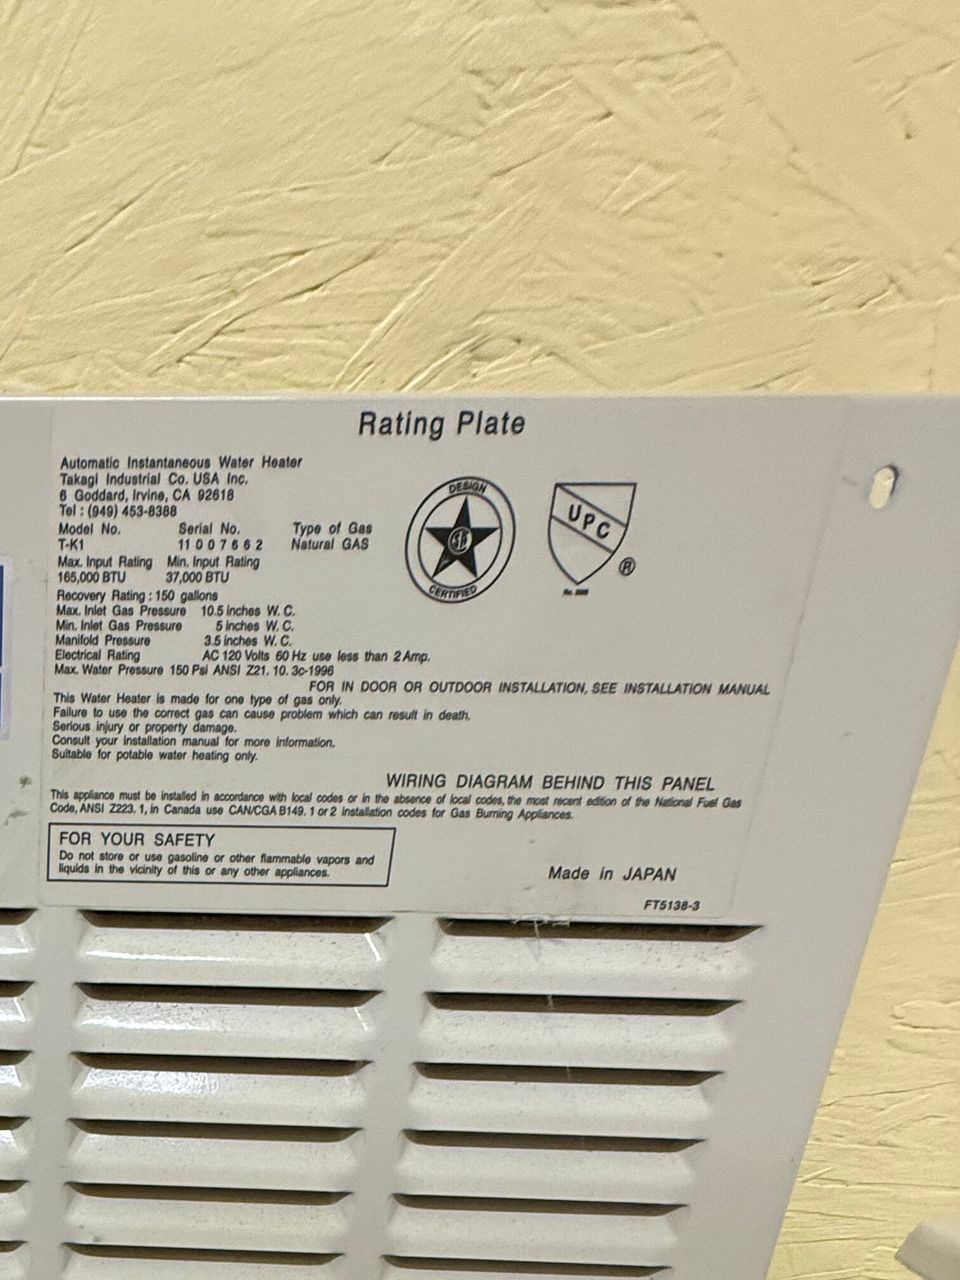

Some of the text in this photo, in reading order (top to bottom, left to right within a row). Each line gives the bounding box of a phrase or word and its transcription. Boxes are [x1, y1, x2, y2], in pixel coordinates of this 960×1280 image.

[358, 410, 525, 441] Rating Plate
[59, 455, 303, 469] Automatic Instantaneous Water Heater
[59, 471, 248, 488] Takagi Industrial Co. USA Inc.
[58, 487, 234, 502] 6 Goddard, Irvine, CA 92618
[449, 482, 487, 494] DESIGN
[58, 503, 76, 516] Tel
[87, 503, 118, 518] (949)
[121, 504, 177, 517] 453-8388
[58, 522, 120, 535] Model No.
[178, 521, 240, 535] Serial No.
[292, 521, 372, 537] Type of Gas
[568, 504, 611, 539] UPC
[57, 538, 84, 550] T-K1
[290, 537, 369, 550] Natural GAS
[57, 555, 153, 570] Max. Input Rating
[166, 554, 260, 570] Min. Input Rating
[57, 570, 126, 584] 165,000 BTU
[165, 570, 229, 584] 37,000 BTU
[428, 584, 477, 600] CERTIFIED
[308, 679, 770, 695] FOR IN DOOR OR OUTDOOR INSTALLATION, SEE INSTALLATION MANUAL
[386, 773, 715, 791] WIRING DIAGRAM BEHIND THIS PANEL
[59, 831, 215, 847] FOR YOUR SAFETY
[547, 865, 677, 881] Made in JAPAN
[643, 899, 701, 911] FT5138-3
